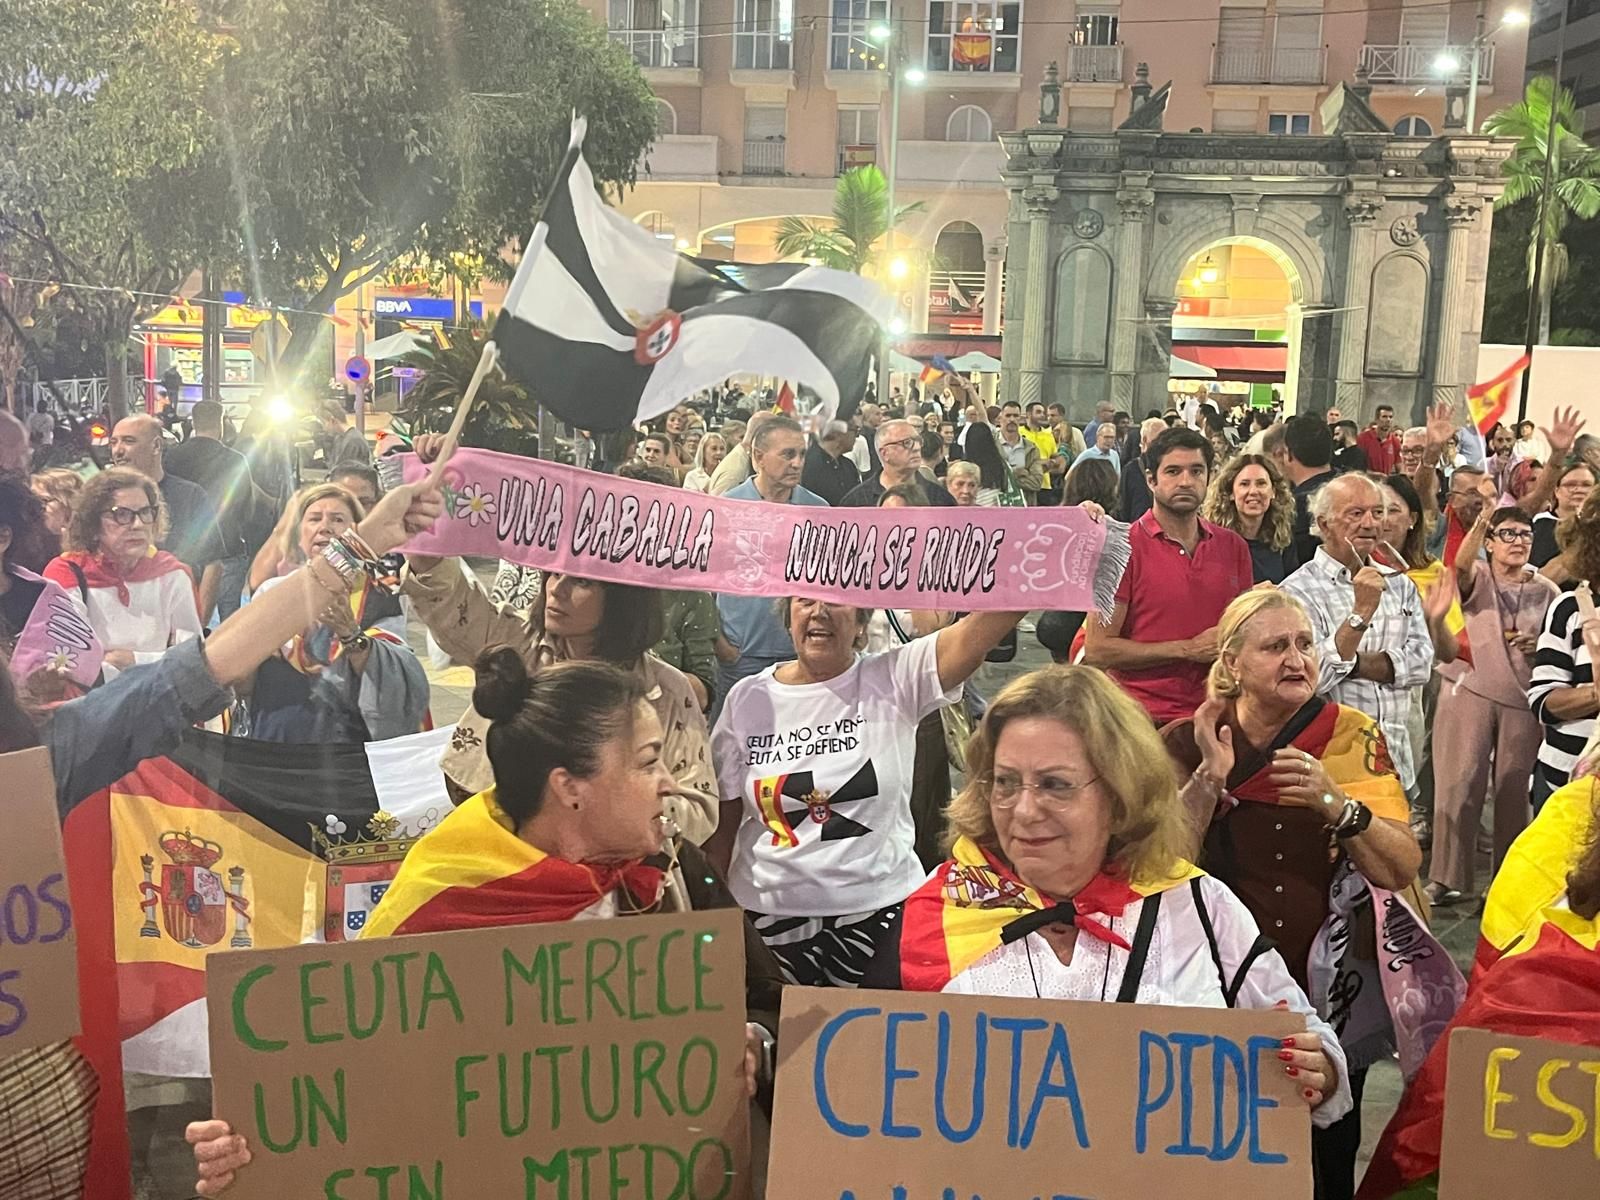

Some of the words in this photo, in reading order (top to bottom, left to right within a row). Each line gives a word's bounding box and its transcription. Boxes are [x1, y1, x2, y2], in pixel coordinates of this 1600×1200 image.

[376, 301, 412, 313] BBVA
[497, 476, 563, 551] UNA
[572, 487, 714, 572] CABALLA
[785, 519, 878, 590] NUNCA
[879, 524, 916, 591] SE
[918, 523, 1004, 595] RINDE
[745, 751, 782, 766] EUTA
[787, 746, 802, 760] SE
[805, 736, 860, 756] DEFIEND
[746, 734, 784, 749] CEUTA
[789, 727, 812, 743] NO
[0, 873, 72, 945] OS
[231, 951, 464, 1052] CEUTA
[503, 929, 724, 1027] MERECE
[254, 1067, 347, 1154] UN
[454, 1037, 718, 1138] FUTURO
[814, 1007, 1091, 1149] CEUTA
[1135, 1029, 1289, 1164] PIDE
